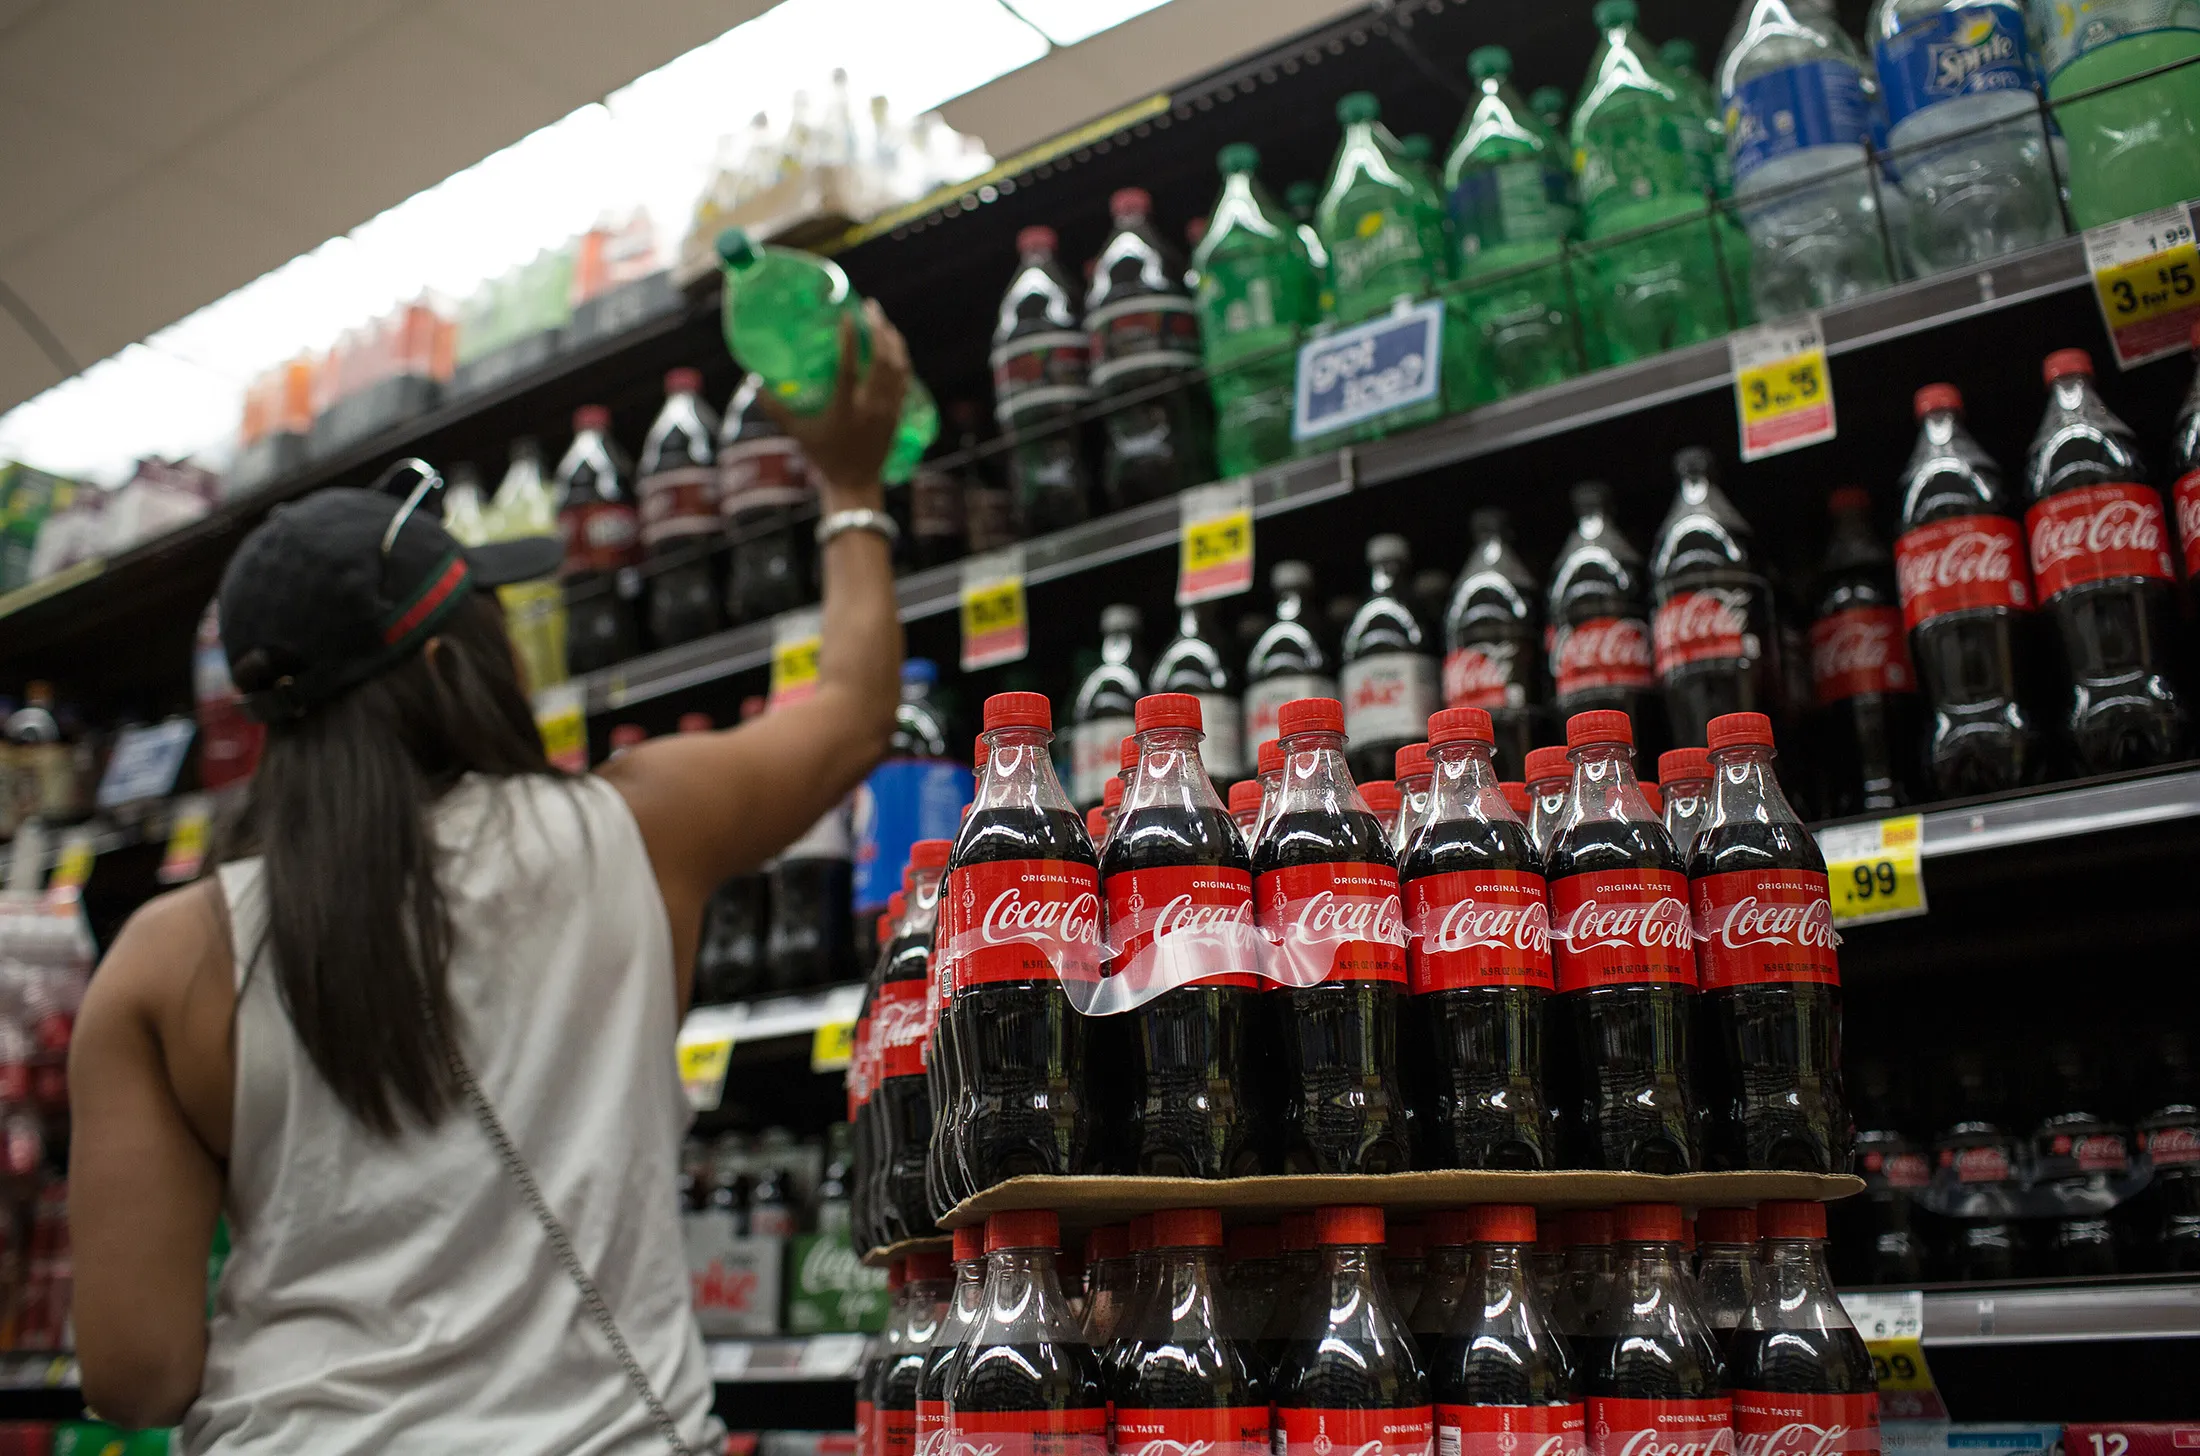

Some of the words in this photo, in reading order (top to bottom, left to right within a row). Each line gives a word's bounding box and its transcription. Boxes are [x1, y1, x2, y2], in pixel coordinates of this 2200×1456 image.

[1936, 35, 2013, 89] Sprite
[2112, 279, 2138, 313] 3
[1021, 874, 1068, 885] ORIGINAL
[1070, 876, 1092, 888] TASTE
[1192, 880, 1235, 890] ORIGINAL
[1333, 877, 1377, 885] ORIGINAL
[1379, 879, 1396, 889] TASTE
[1474, 885, 1520, 893] ORIGINAL
[1521, 887, 1541, 897] TASTE
[1596, 883, 1645, 893] ORIGINAL
[1647, 883, 1672, 892] TASTE
[1757, 882, 1802, 891] ORIGINAL
[1804, 884, 1824, 893] TASTE
[982, 888, 1100, 946] Coca-Col
[1438, 898, 1552, 955] Coca-Col
[1771, 1407, 1803, 1417] TASTE
[1658, 1415, 1706, 1424] ORIGINAL
[1708, 1413, 1728, 1422] TASTE
[1136, 1424, 1165, 1434] TASTE
[1383, 1424, 1423, 1434] ORIGINAL
